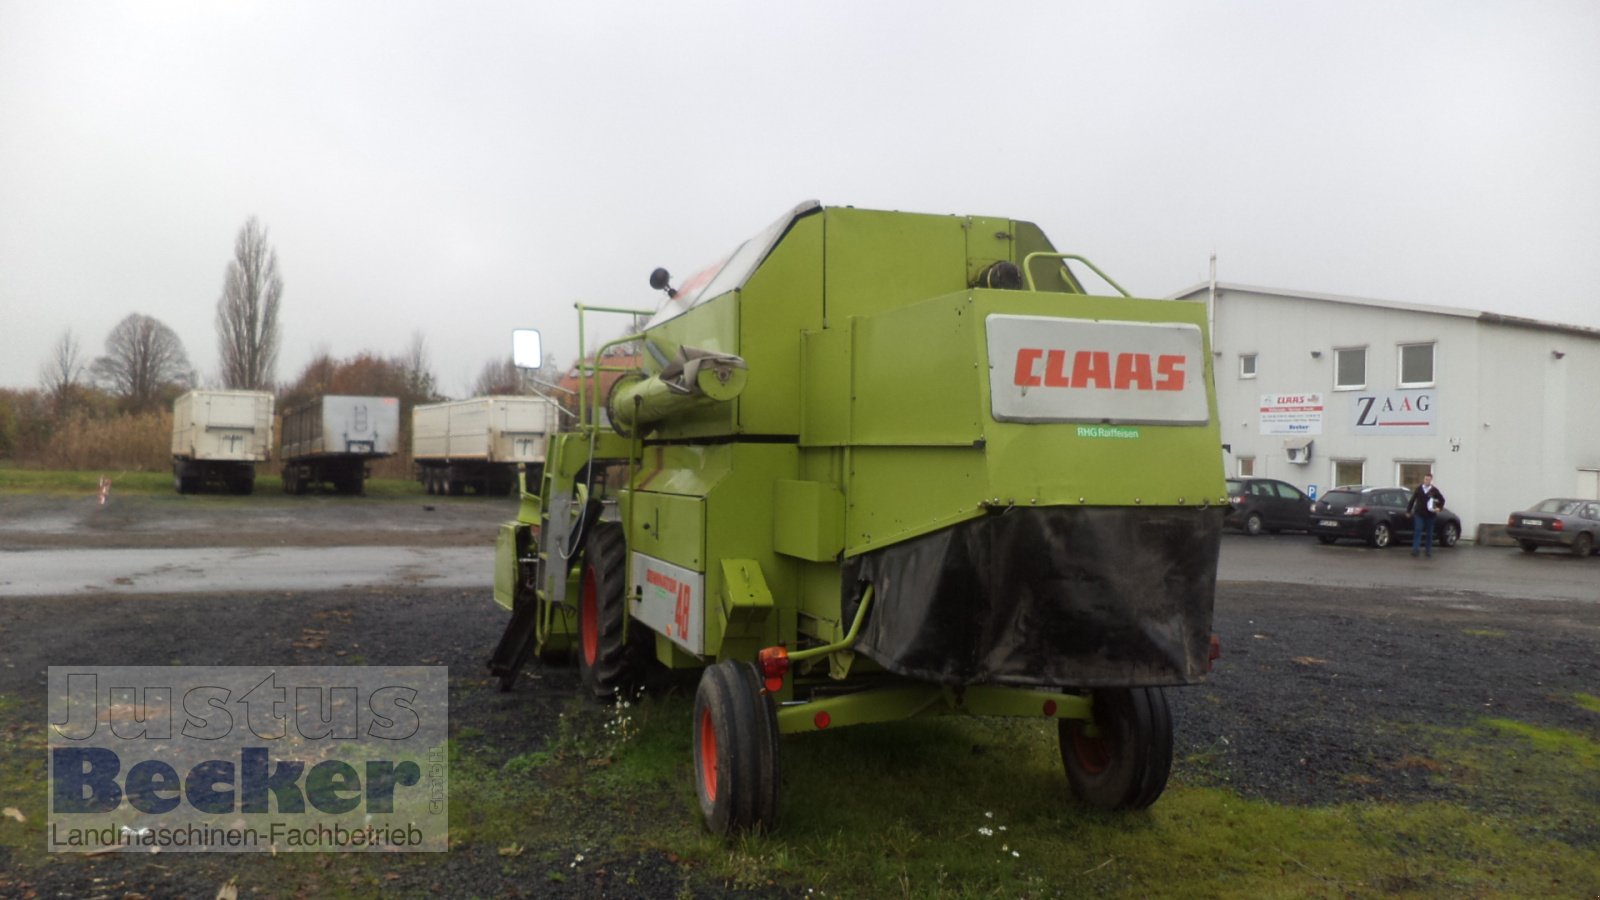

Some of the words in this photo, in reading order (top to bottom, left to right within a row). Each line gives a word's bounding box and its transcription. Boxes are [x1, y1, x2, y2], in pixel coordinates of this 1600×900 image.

[1014, 348, 1186, 391] CLAAS
[1077, 427, 1097, 437] RHG
[1098, 427, 1139, 439] Raiffeisen
[1308, 486, 1316, 498] P
[675, 583, 690, 640] 48
